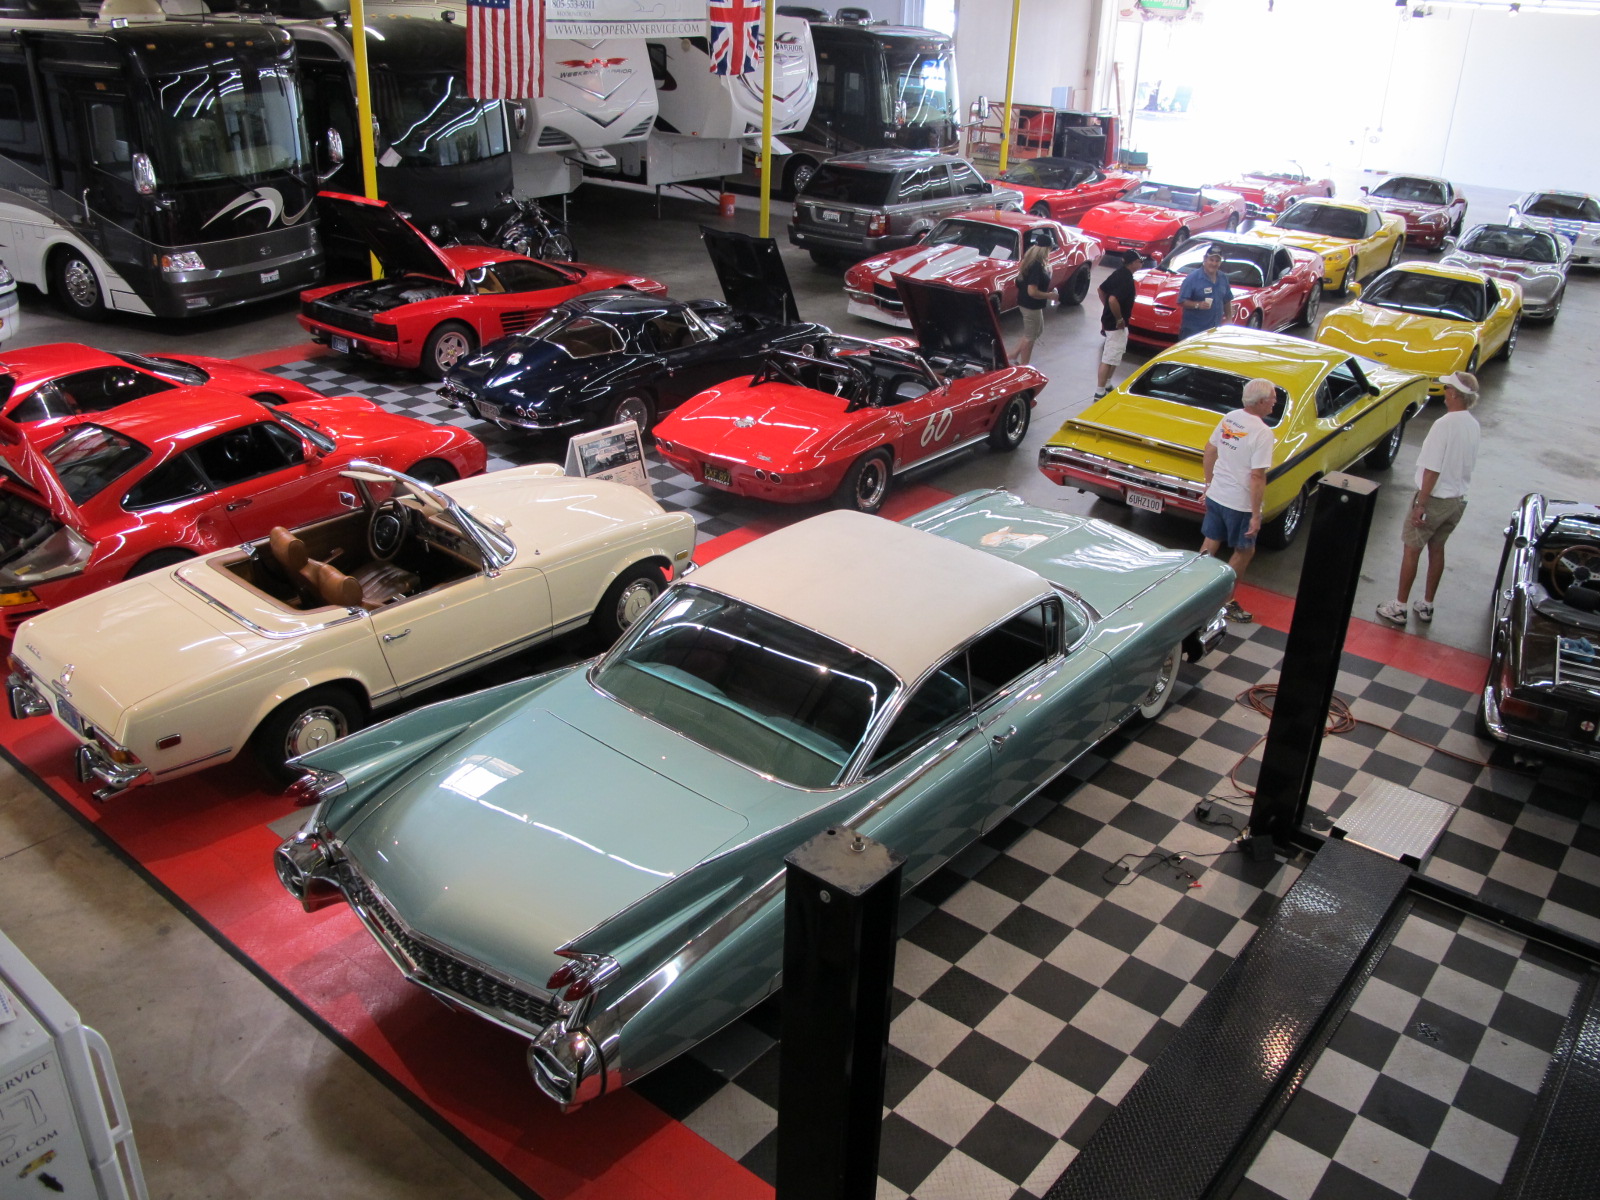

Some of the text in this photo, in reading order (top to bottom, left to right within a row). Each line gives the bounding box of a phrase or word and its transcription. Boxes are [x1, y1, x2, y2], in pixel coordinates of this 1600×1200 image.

[554, 23, 700, 36] WWW.HOOPERRVSERVICE.COM
[560, 69, 598, 78] WEEKEND
[920, 407, 953, 447] 60
[1128, 494, 1160, 511] 6UHZ100
